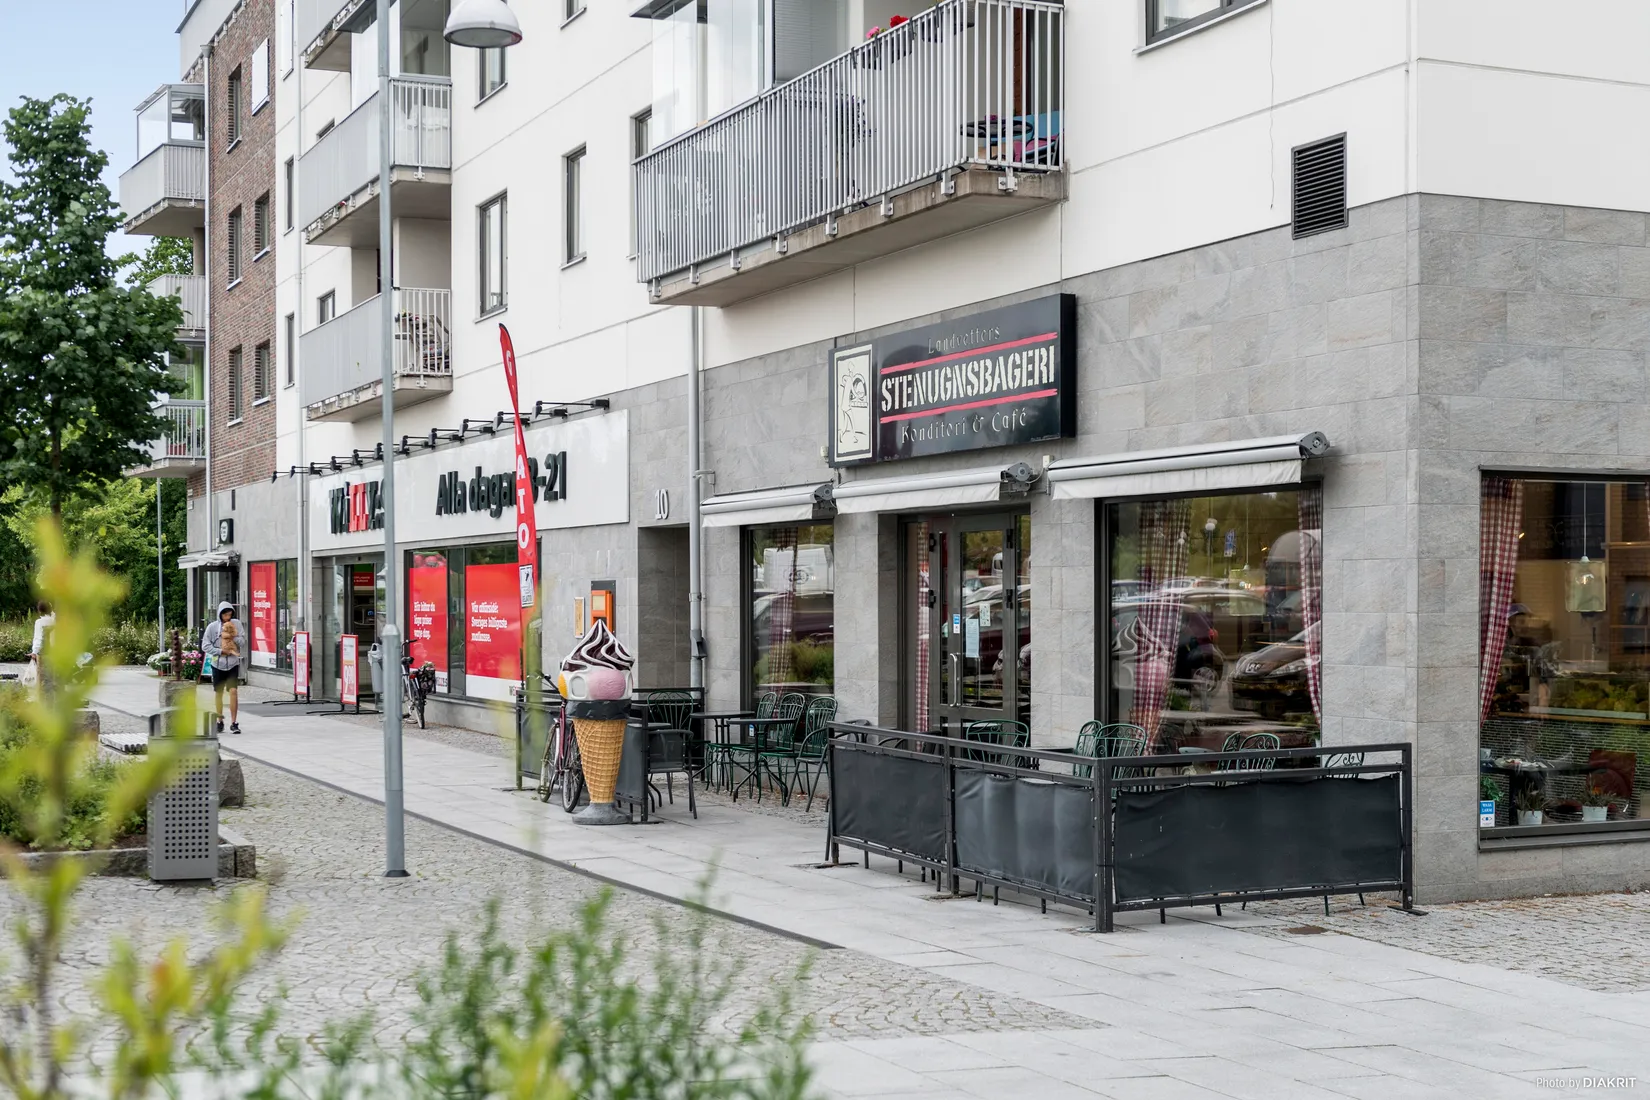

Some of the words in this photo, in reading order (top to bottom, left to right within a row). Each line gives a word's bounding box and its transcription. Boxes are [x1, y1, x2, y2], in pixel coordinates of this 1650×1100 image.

[928, 326, 1000, 354] Landvetters
[881, 345, 1055, 412] STENUGNSBAGERI
[902, 417, 966, 444] Konditori
[972, 413, 985, 433] &
[991, 407, 1027, 433] Café
[436, 471, 467, 515] Alla
[655, 488, 670, 520] 10
